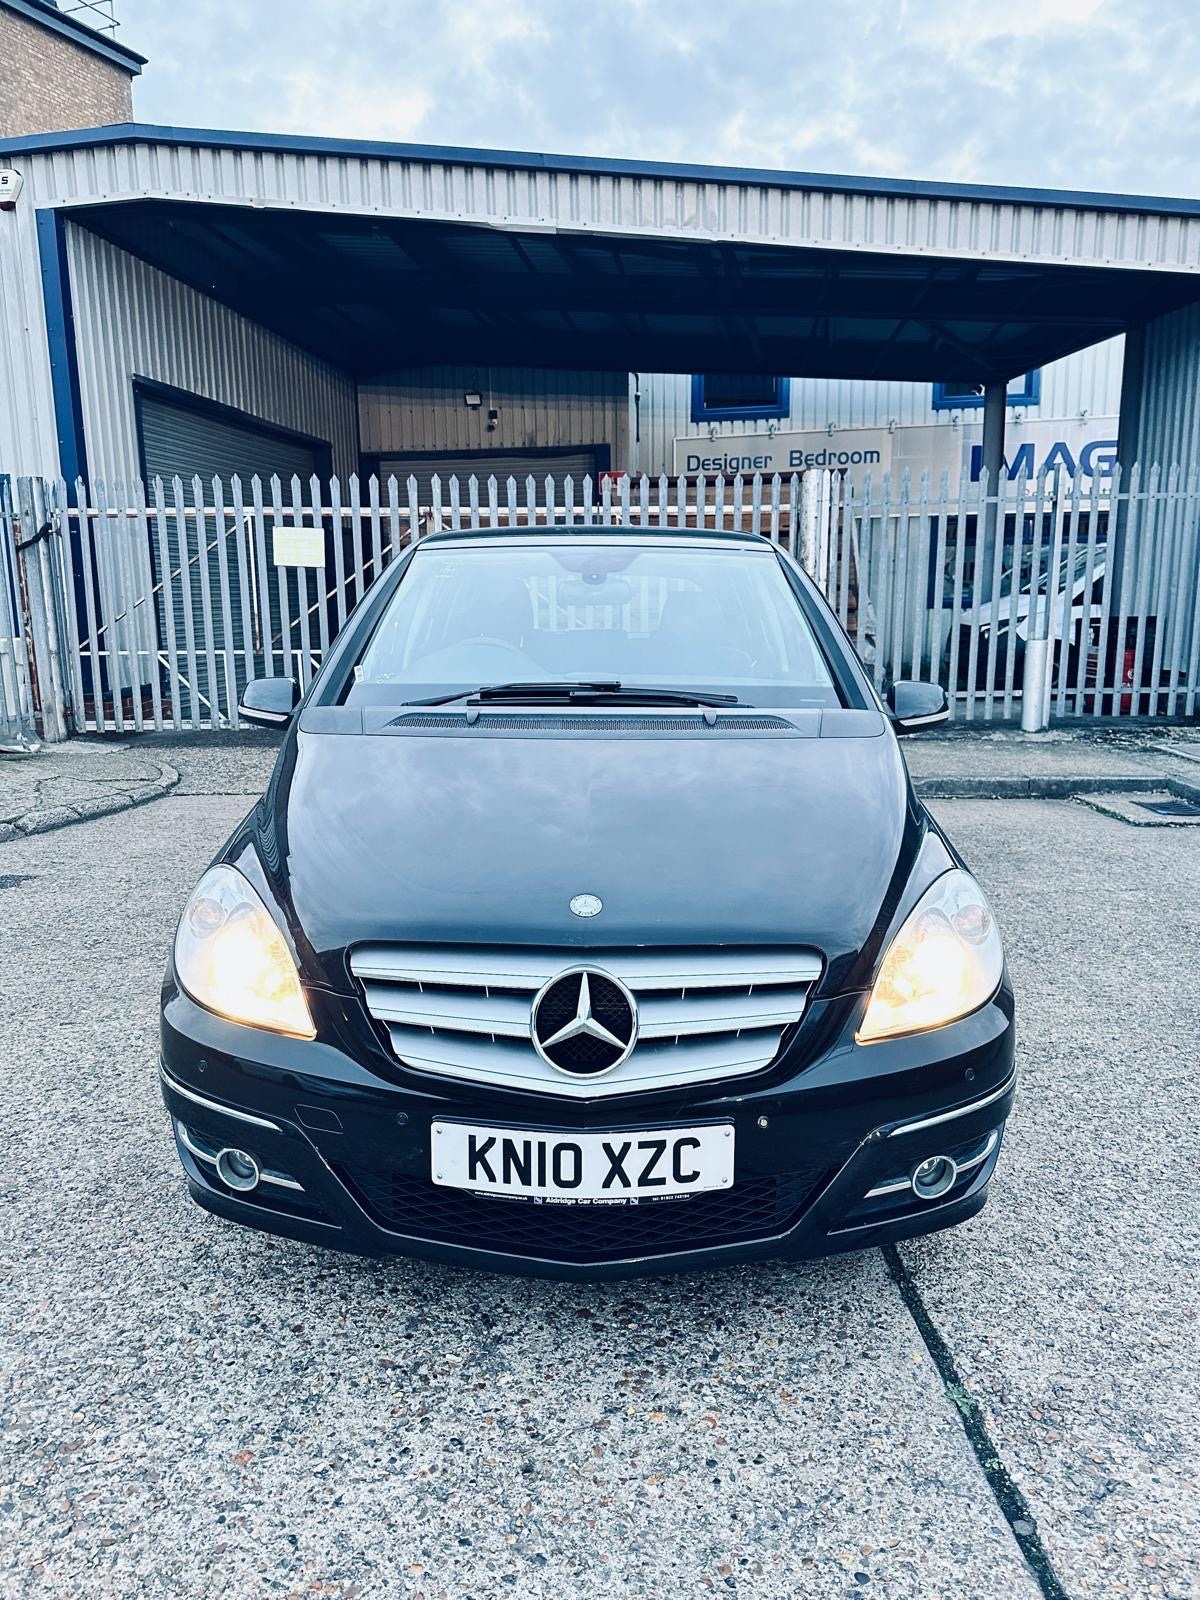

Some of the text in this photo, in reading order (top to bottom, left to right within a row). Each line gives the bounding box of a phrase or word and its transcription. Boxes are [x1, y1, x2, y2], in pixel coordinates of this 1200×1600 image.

[687, 449, 880, 474] Designer Bedroom
[468, 1134, 701, 1189] KN10 XZC
[545, 1196, 627, 1206] Aldridge Car Company
